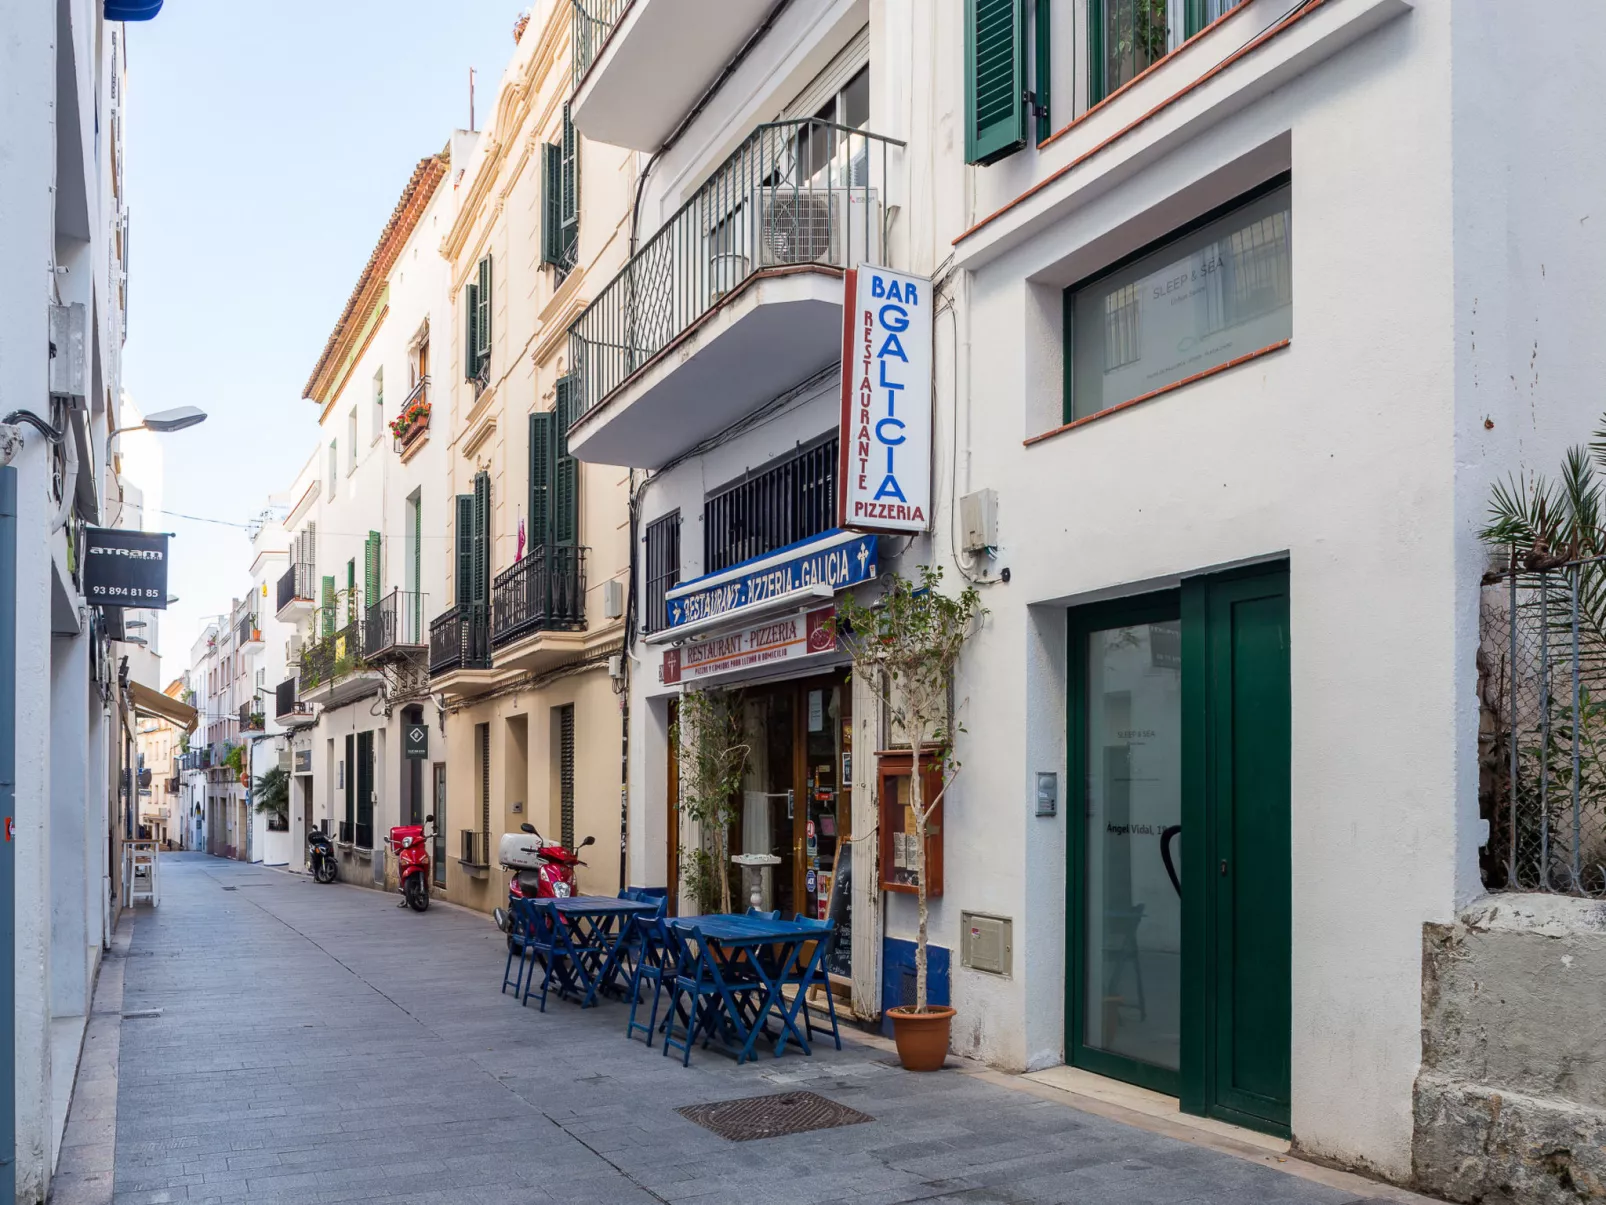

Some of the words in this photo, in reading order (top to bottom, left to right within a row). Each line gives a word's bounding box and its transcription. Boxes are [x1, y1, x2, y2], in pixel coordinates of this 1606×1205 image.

[871, 275, 918, 306] BAR
[1153, 273, 1188, 300] SLEEP
[1200, 256, 1224, 277] SEA
[857, 310, 873, 490] RESTAURANTE
[873, 304, 910, 503] GALICIA
[855, 501, 925, 522] PIZZERIA
[801, 549, 850, 588] GALICIA
[93, 586, 106, 595] 93
[109, 587, 128, 595] 894
[130, 588, 142, 597] 81
[146, 589, 159, 598] 85
[687, 634, 743, 664] RESTAURANT
[750, 620, 798, 649] PIZZERIA
[1131, 824, 1154, 836] Vidal,
